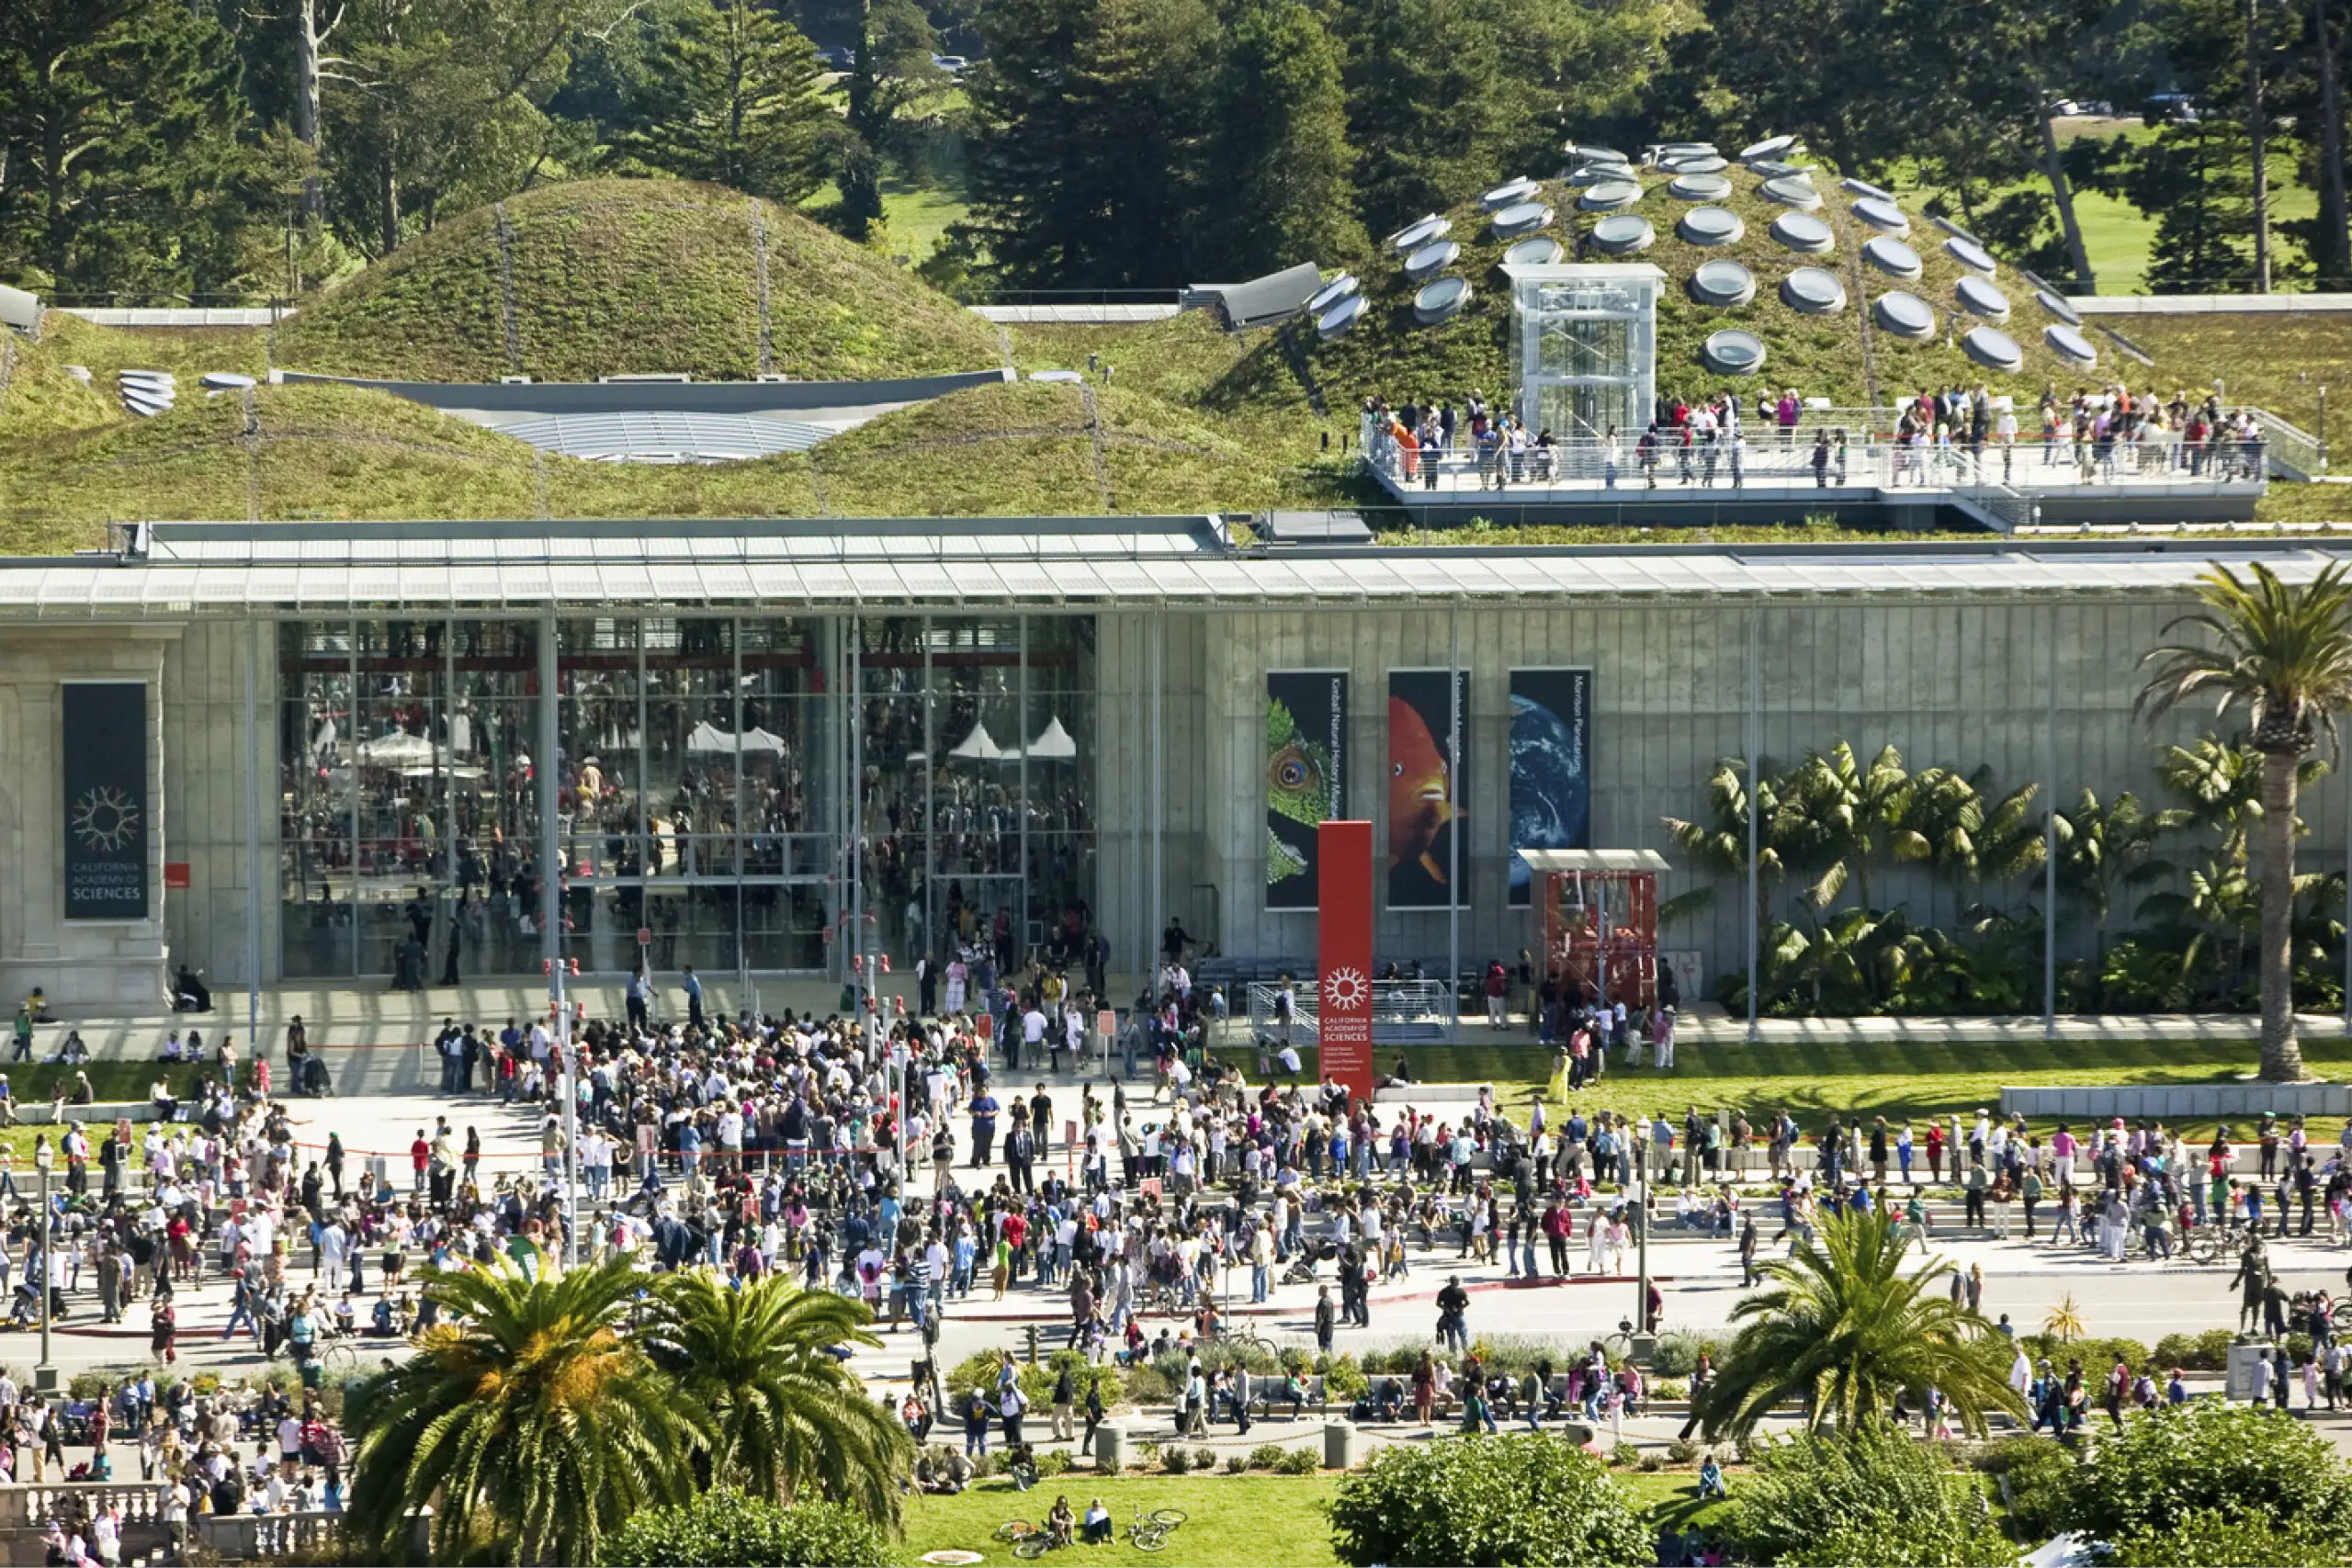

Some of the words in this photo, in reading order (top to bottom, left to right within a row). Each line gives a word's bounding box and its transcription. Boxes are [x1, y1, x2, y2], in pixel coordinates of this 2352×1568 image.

[1331, 678, 1340, 713] Kimball
[1574, 676, 1583, 716] Morrison
[1331, 714, 1340, 748] Natural
[1330, 750, 1340, 783] History
[1331, 784, 1340, 818] Museu
[73, 862, 140, 872] CALIFORNIA
[74, 874, 123, 884] ACADEMY
[126, 874, 139, 884] OF
[73, 886, 141, 899] SCIENCES
[1324, 1033, 1368, 1042] SCIENCES
